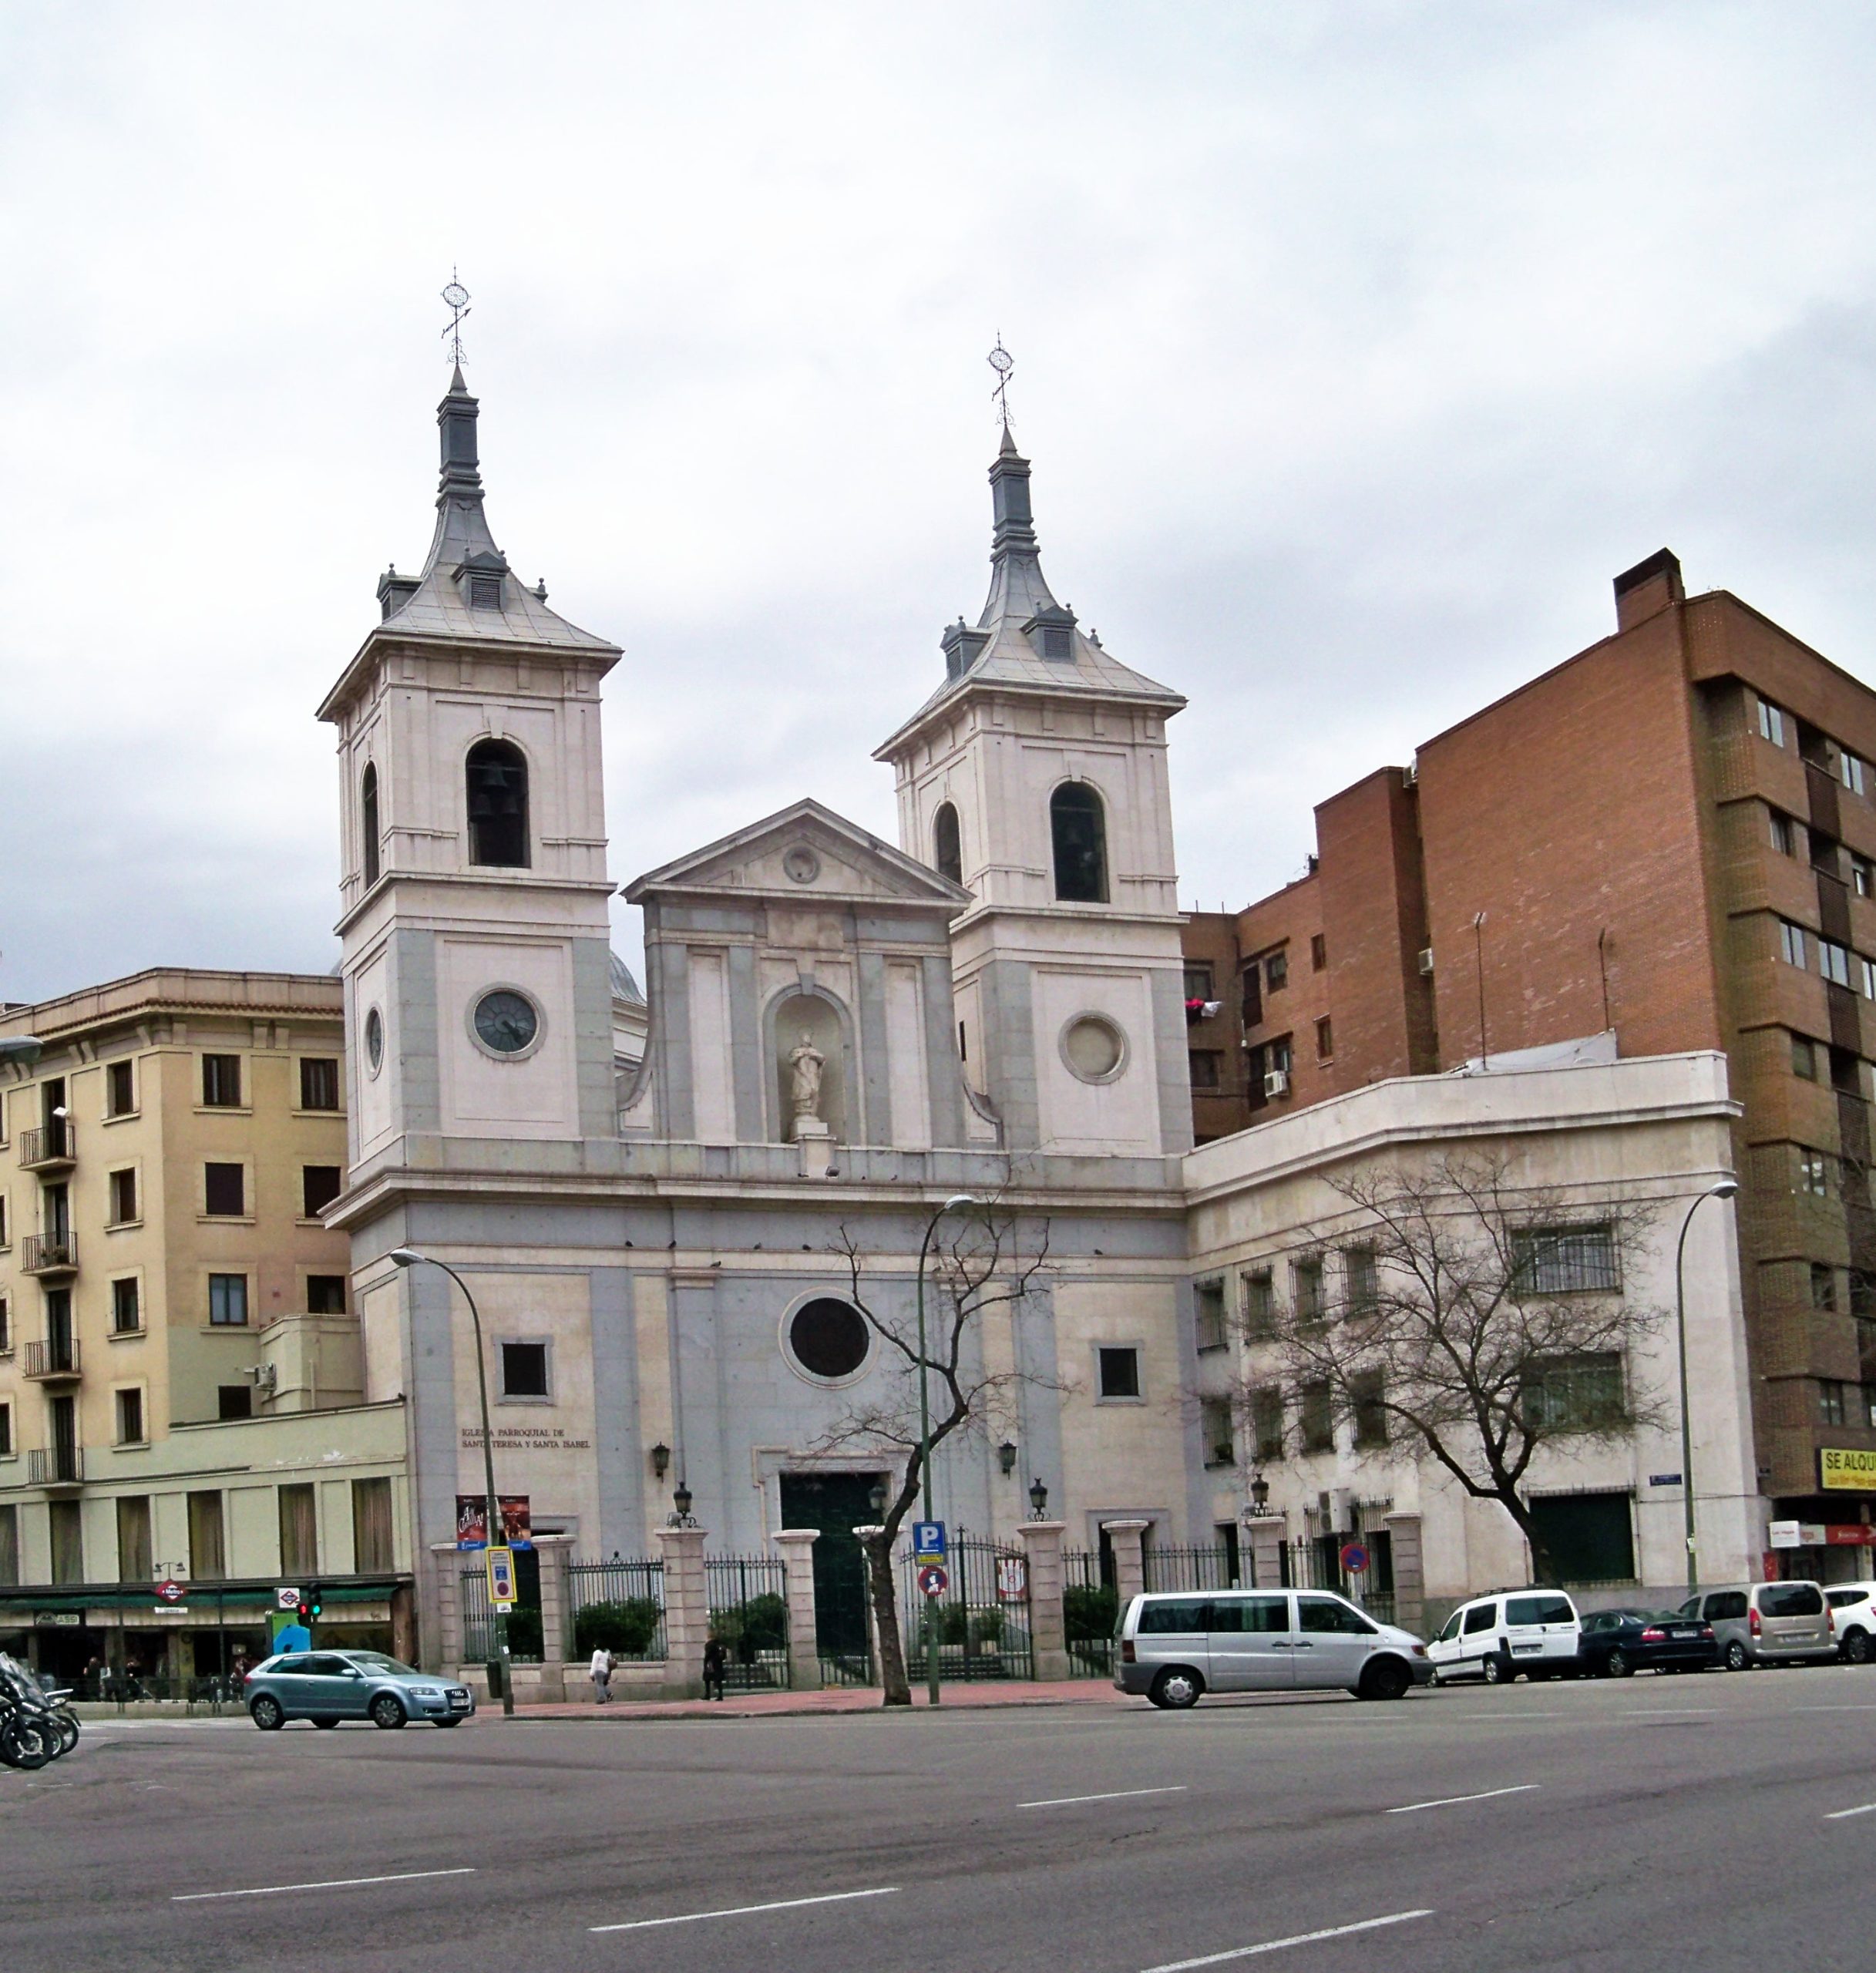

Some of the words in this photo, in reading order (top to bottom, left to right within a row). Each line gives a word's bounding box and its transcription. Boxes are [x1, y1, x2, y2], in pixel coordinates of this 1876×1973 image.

[498, 1429, 550, 1437] PARROQUIAL
[492, 1440, 523, 1448] TERESA
[1826, 1452, 1841, 1470] SE
[1844, 1454, 1876, 1471] ALQU
[920, 1526, 939, 1548] P
